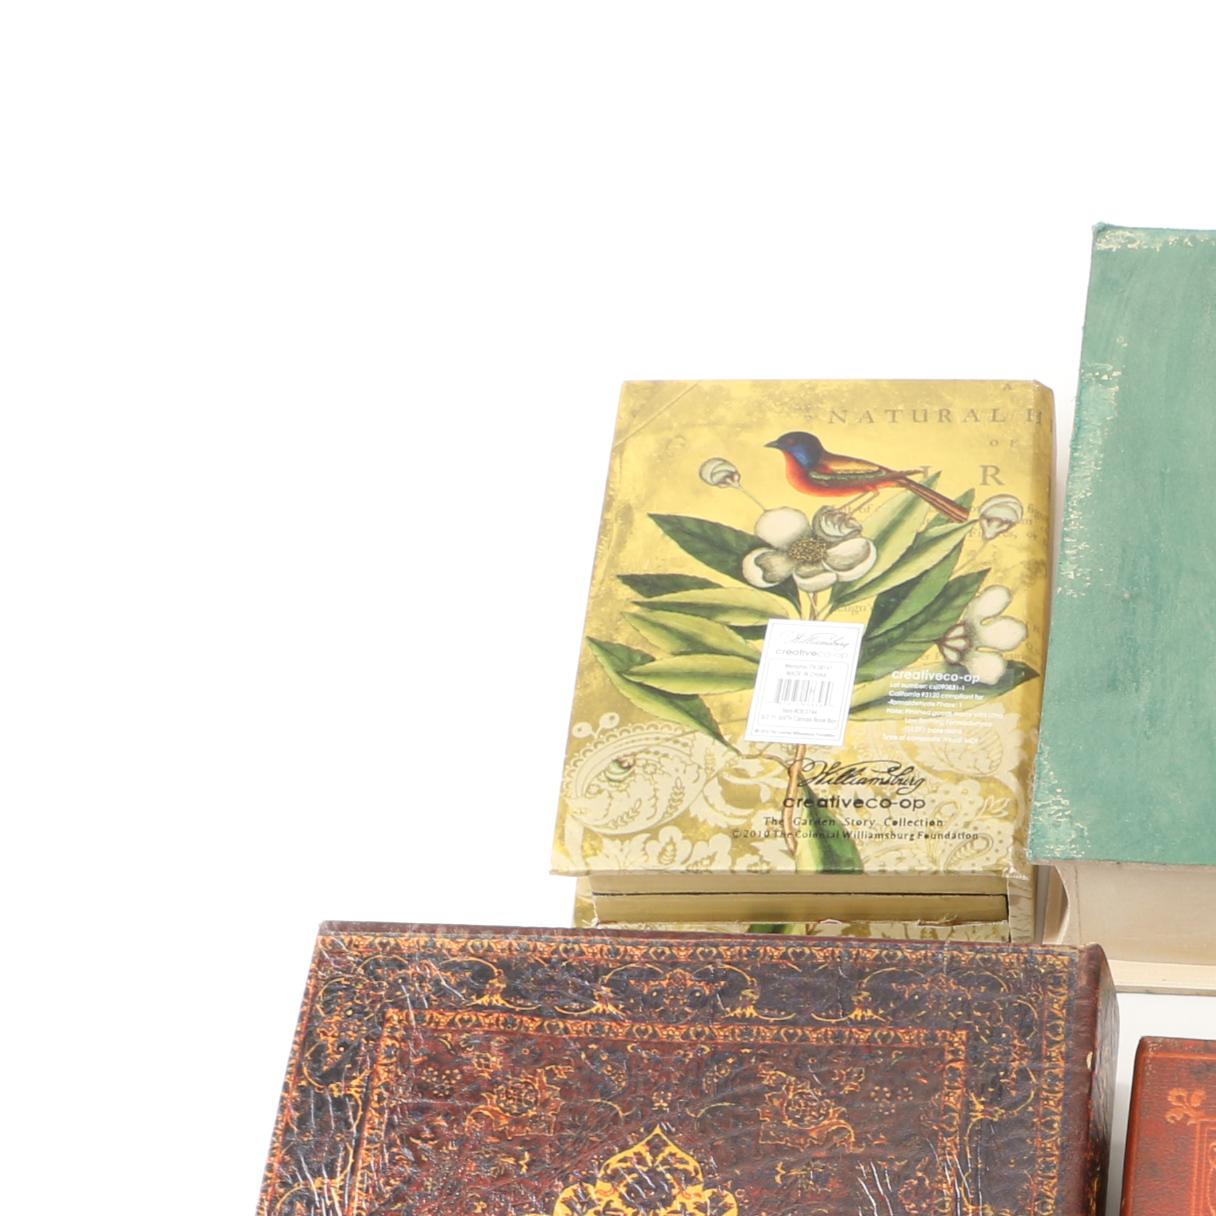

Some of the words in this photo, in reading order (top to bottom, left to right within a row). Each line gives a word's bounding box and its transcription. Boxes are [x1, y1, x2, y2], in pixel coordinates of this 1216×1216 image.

[828, 408, 1008, 424] NATURAL
[891, 670, 980, 685] creativeco-op
[785, 757, 926, 795] Williamsburg
[783, 795, 926, 811] creativeco-op
[763, 816, 784, 826] The
[793, 817, 836, 826] Garden
[845, 817, 875, 828] Story
[884, 818, 943, 827] Collection
[774, 829, 793, 838] The
[795, 830, 840, 839] Colonial
[843, 831, 915, 841] Williamsburg
[918, 831, 979, 840] Foundation
